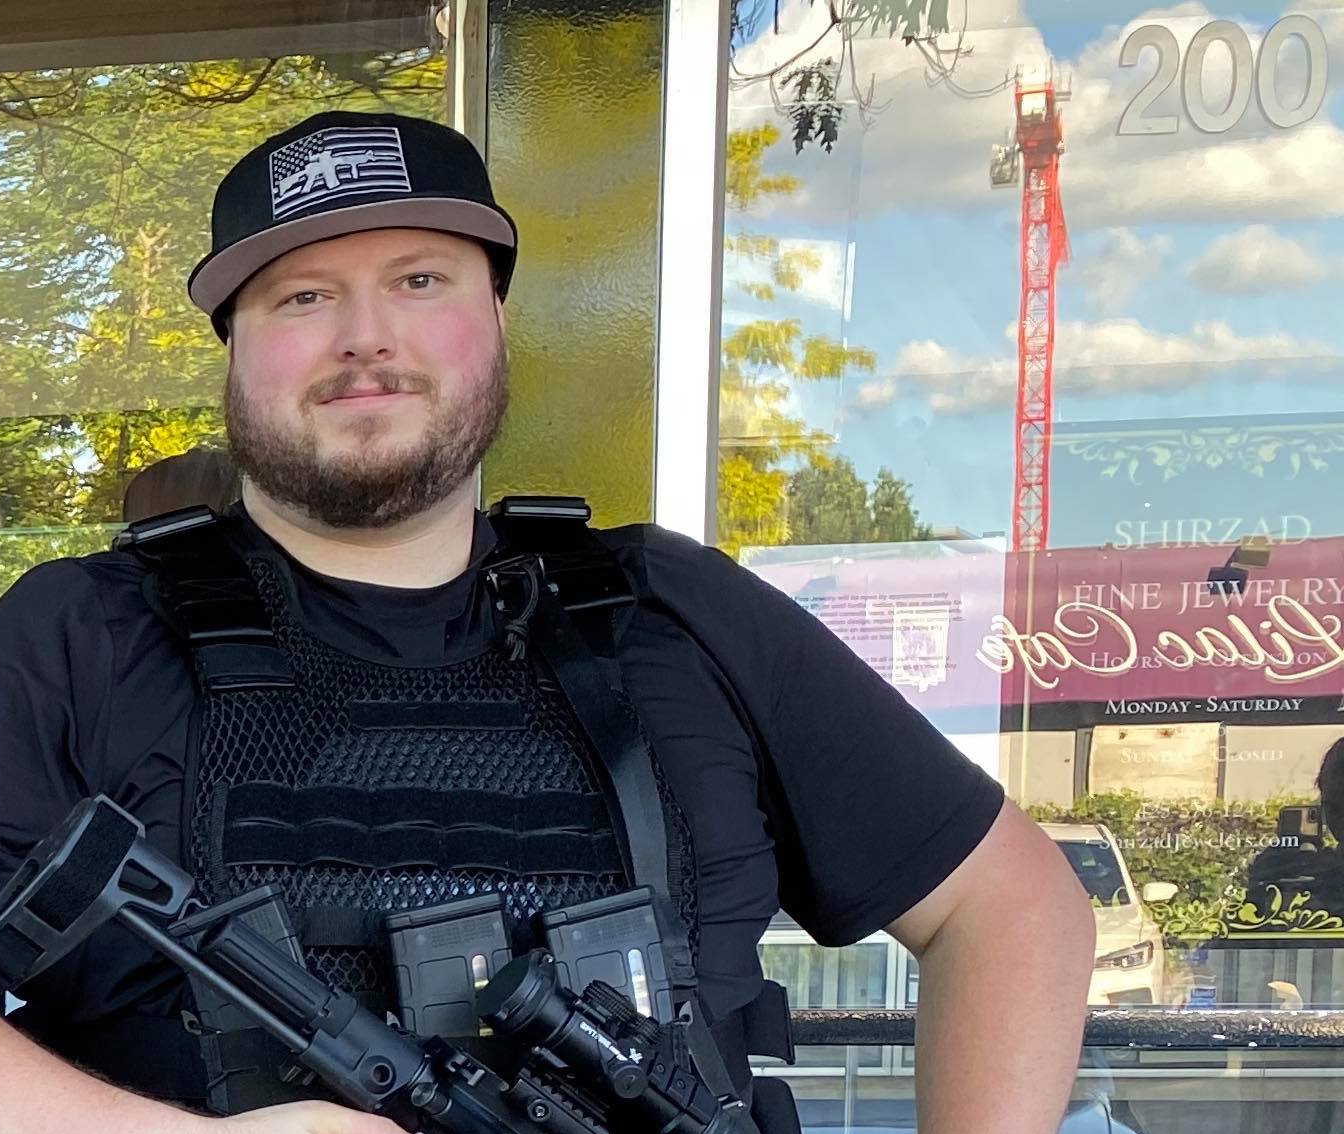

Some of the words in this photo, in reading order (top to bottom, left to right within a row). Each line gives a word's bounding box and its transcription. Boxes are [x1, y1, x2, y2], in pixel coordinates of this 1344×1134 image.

[1115, 14, 1328, 136] 200
[1114, 514, 1313, 551] SHIRZAD
[1072, 581, 1162, 612] FINE
[1177, 576, 1344, 615] JEWELRY
[1090, 651, 1162, 669] HOURS
[1105, 698, 1192, 715] MONDAY
[1206, 696, 1304, 713] SATURDAY
